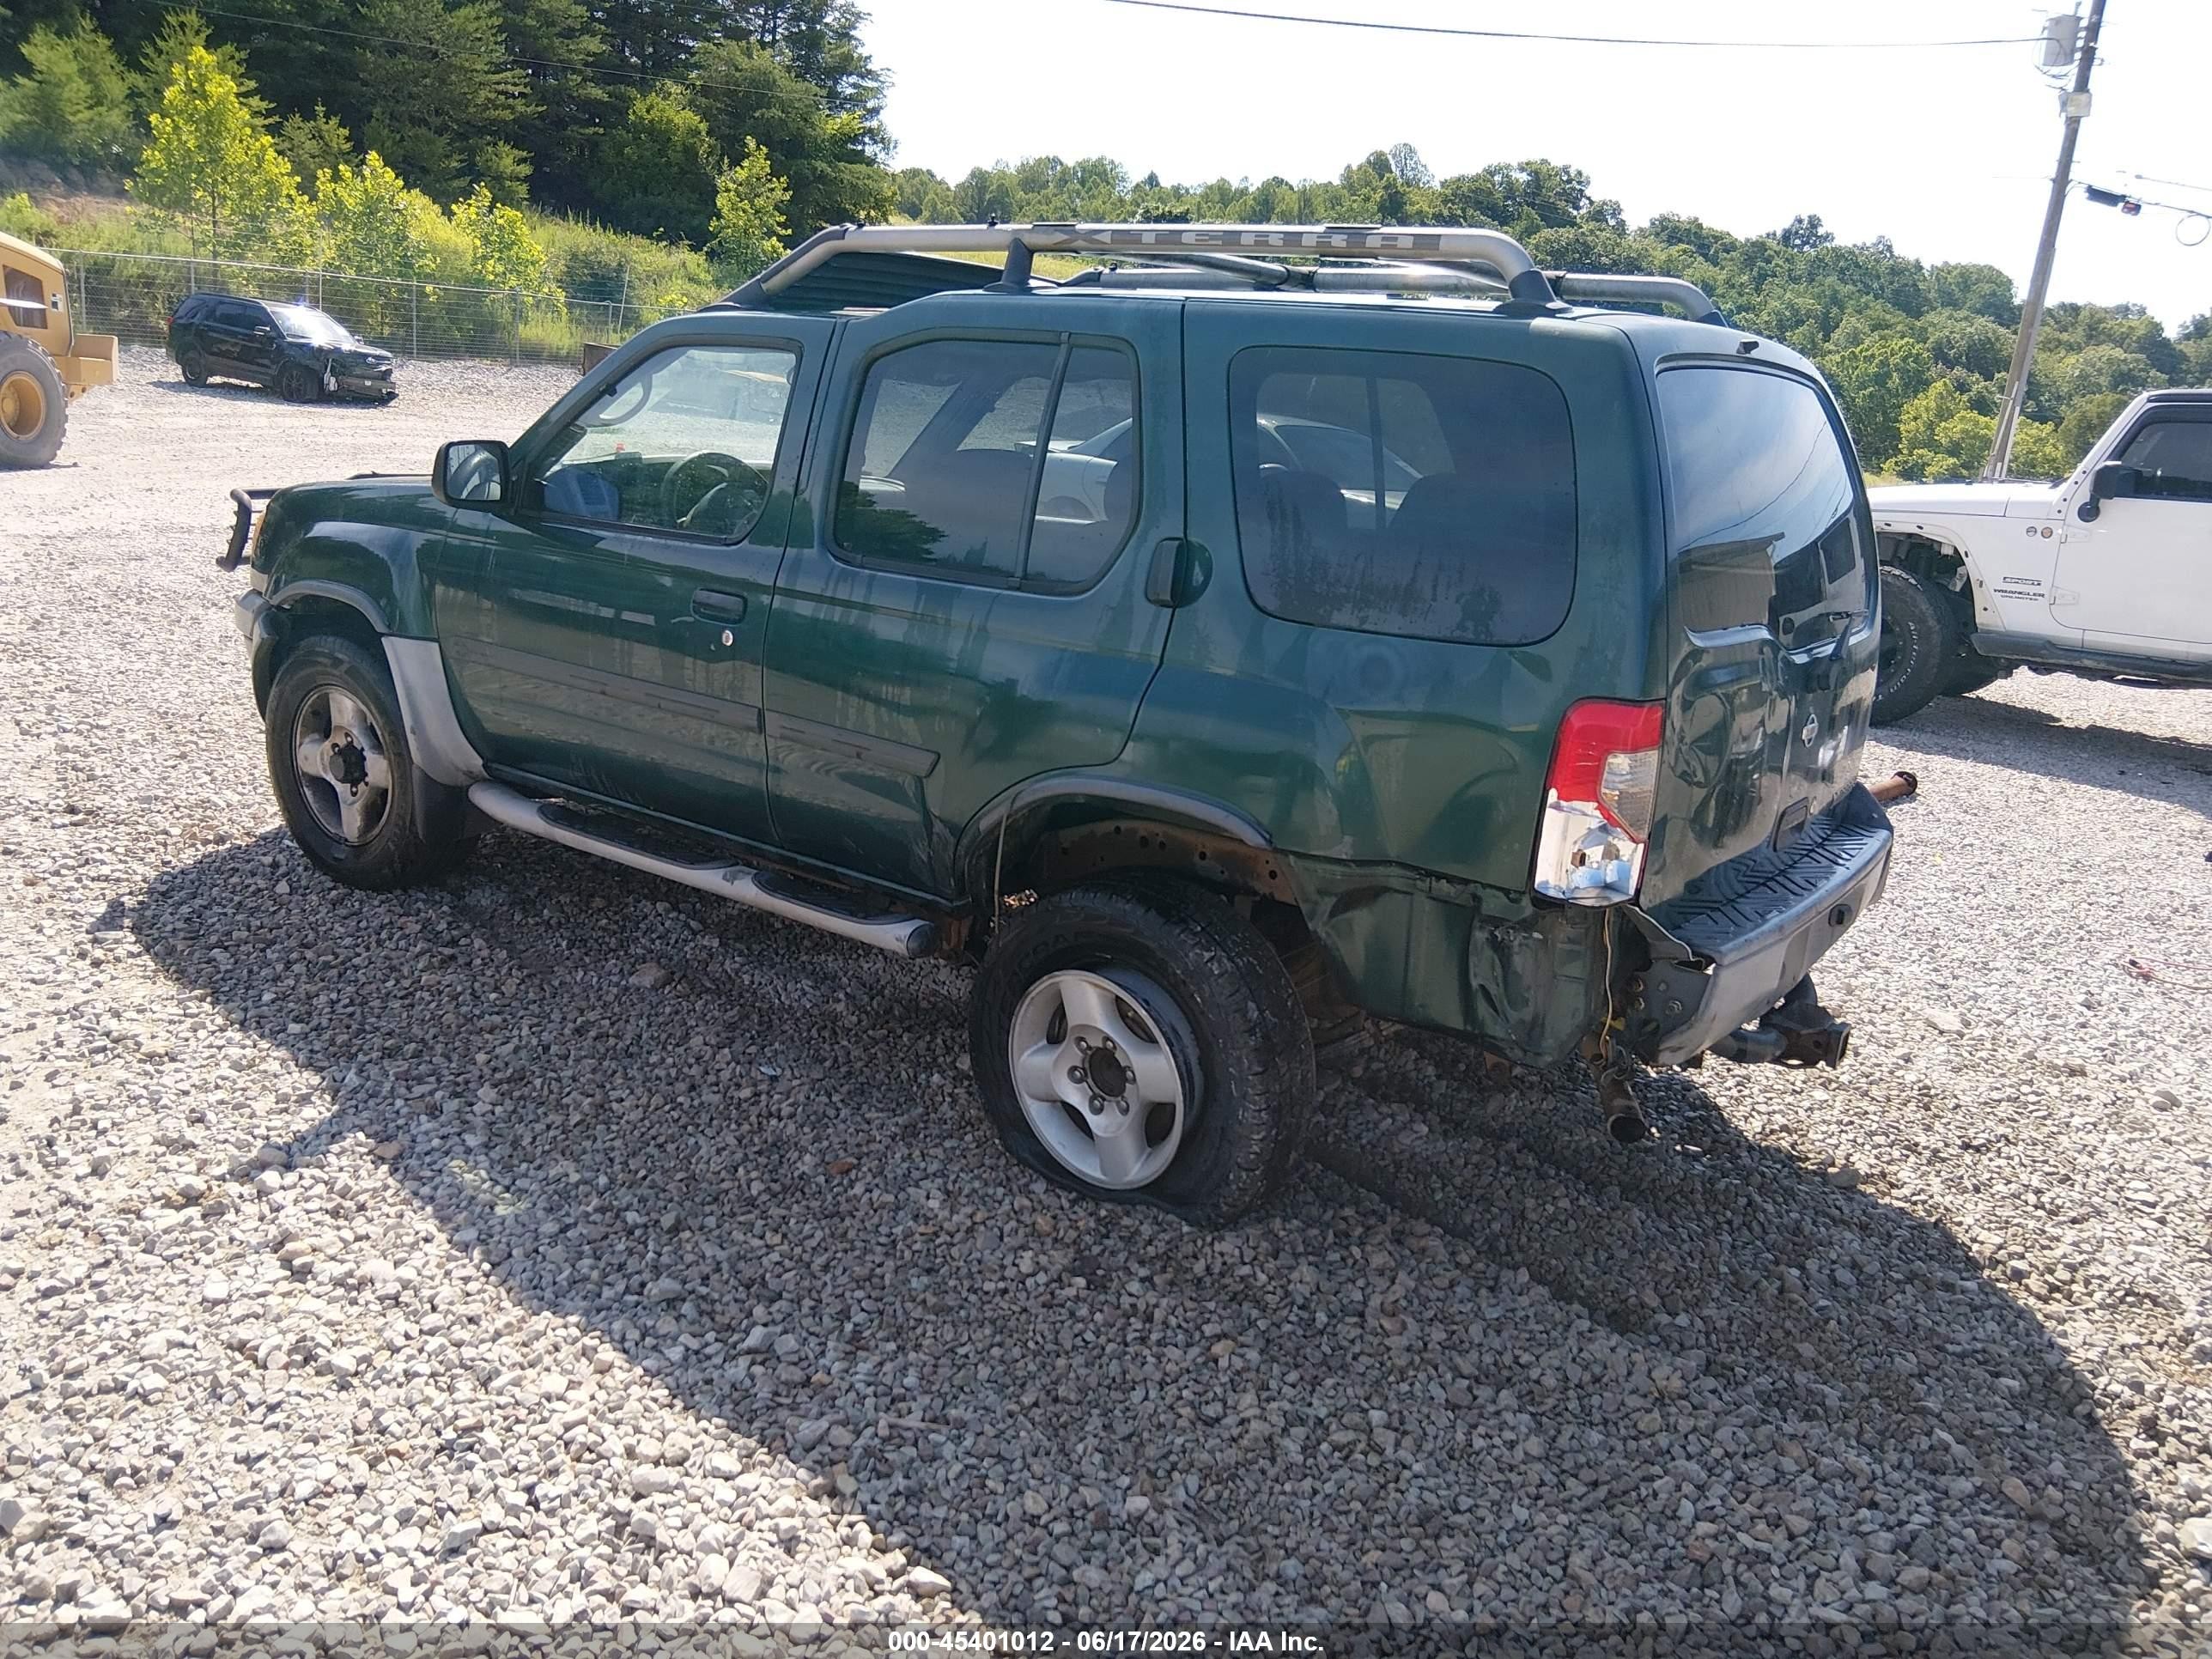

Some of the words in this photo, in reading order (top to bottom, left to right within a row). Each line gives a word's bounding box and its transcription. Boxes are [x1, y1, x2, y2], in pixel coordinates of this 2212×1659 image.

[1053, 229, 1414, 249] XTERRA
[2002, 577, 2042, 586] SPORT
[1993, 588, 2045, 599] WRANGLER
